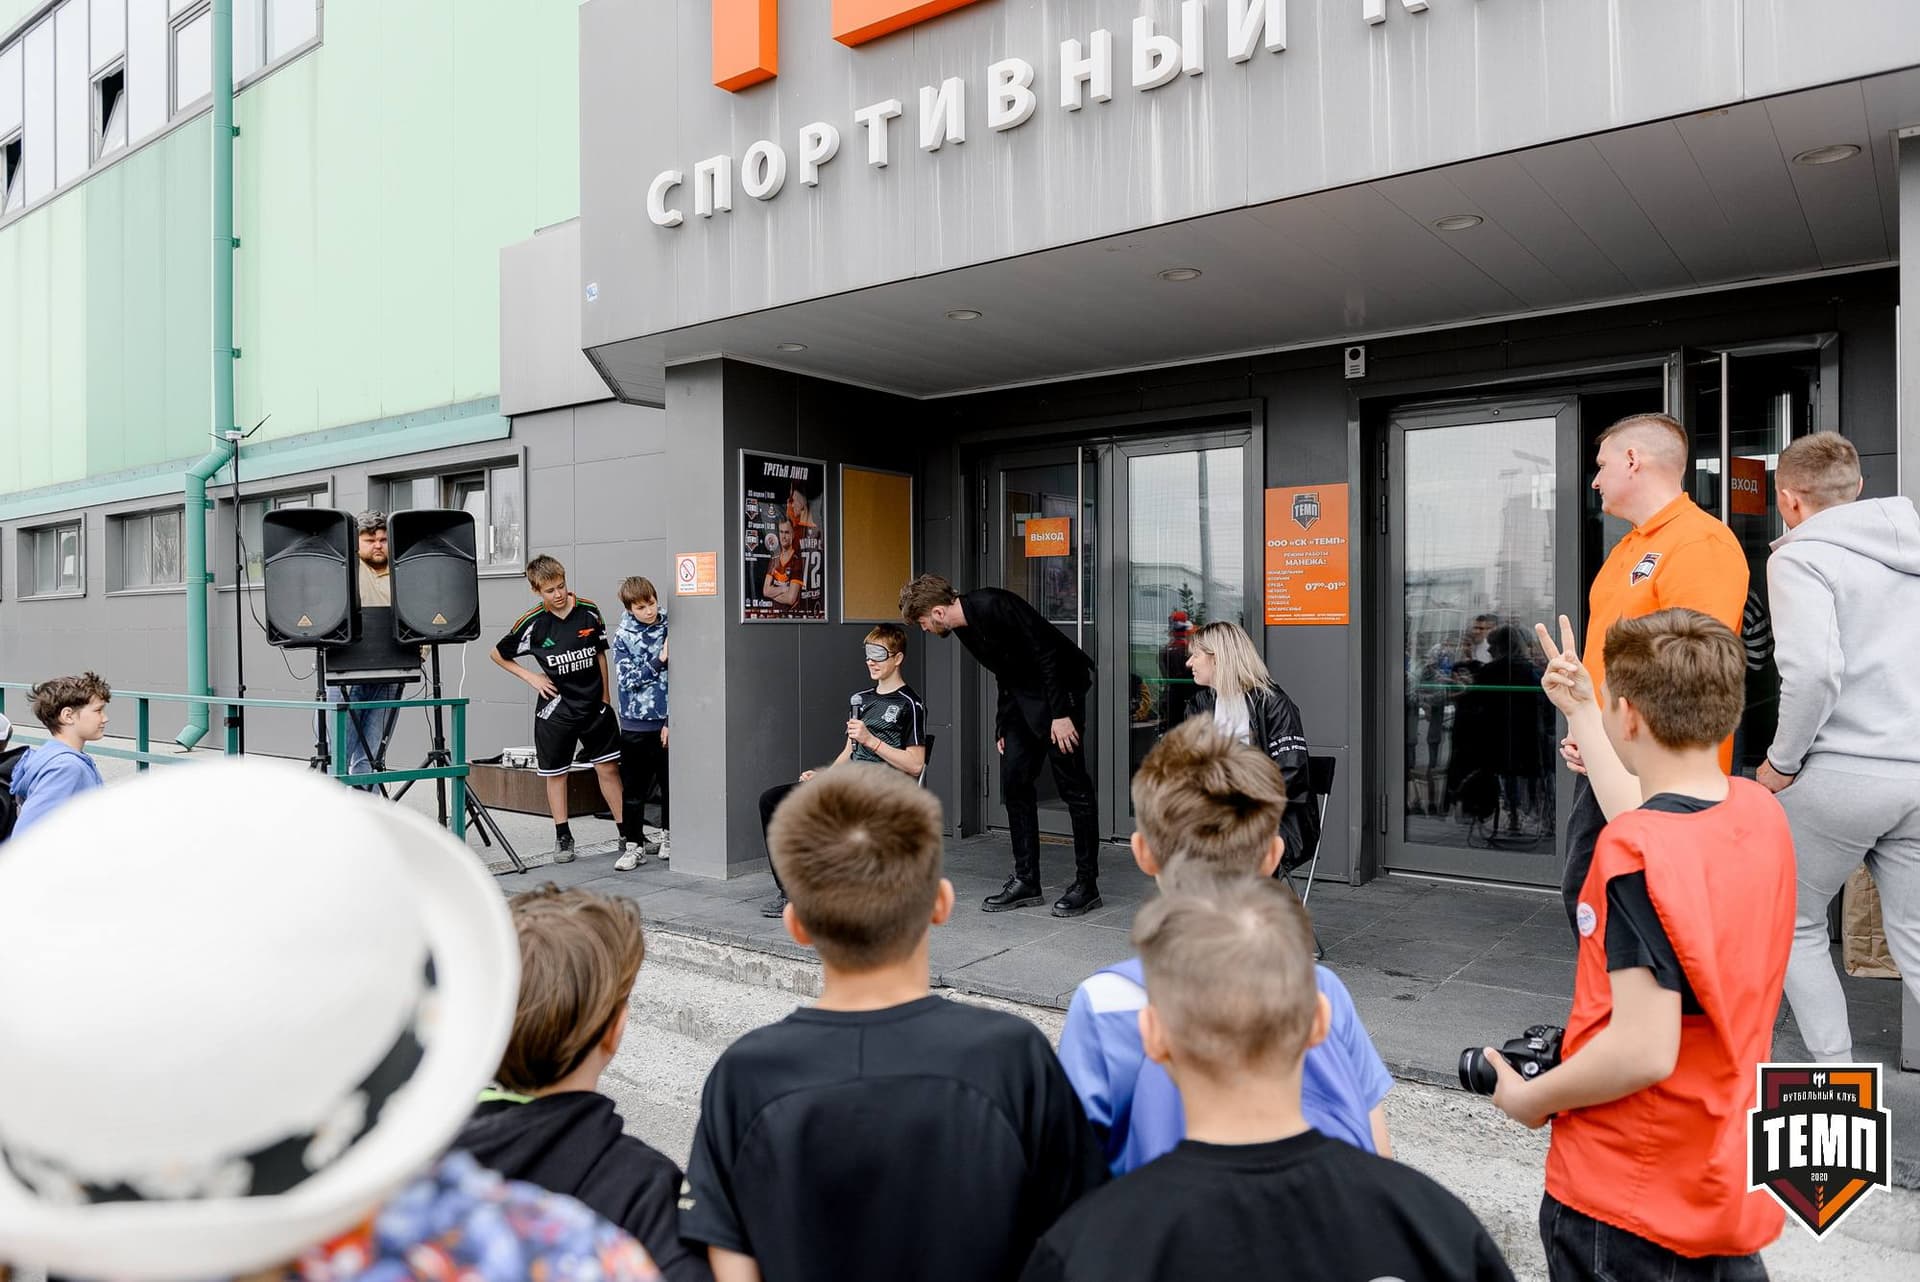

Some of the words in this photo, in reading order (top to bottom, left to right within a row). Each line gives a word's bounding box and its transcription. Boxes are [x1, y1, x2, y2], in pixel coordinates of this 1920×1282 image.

[763, 462, 789, 478] ТРЕТЬЯ
[1731, 478, 1758, 494] ВХОД
[1294, 503, 1318, 518] ТЕМП
[1031, 531, 1065, 543] ВЫХОД
[1267, 539, 1288, 547] ООО
[801, 551, 821, 590] 72
[546, 645, 597, 667] Emirates
[558, 663, 569, 675] FLY
[571, 658, 593, 672] BETTER
